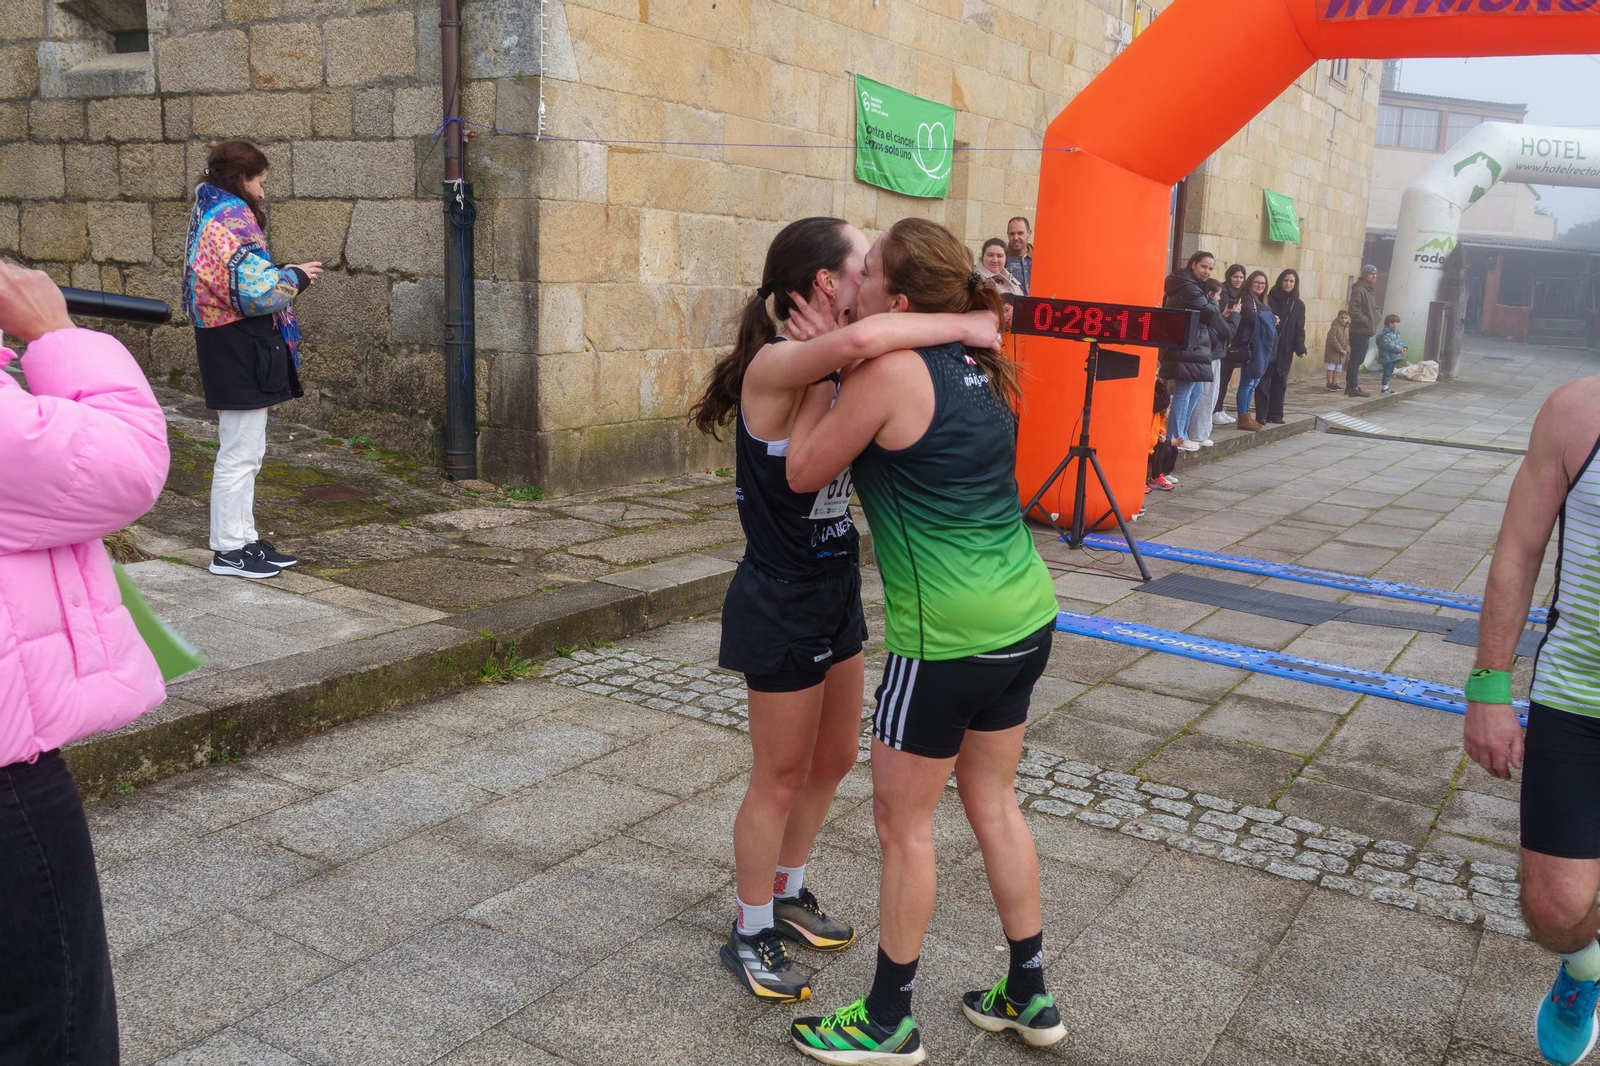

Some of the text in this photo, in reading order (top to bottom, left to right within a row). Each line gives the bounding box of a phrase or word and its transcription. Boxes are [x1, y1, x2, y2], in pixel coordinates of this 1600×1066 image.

[865, 122, 915, 148] ontra el cáncer
[885, 144, 899, 156] solo
[900, 149, 912, 160] uno
[1521, 137, 1586, 160] HOTEL
[1414, 252, 1446, 264] rode
[1034, 303, 1151, 340] 0:28:11
[1117, 628, 1242, 658] CRONOTEC
